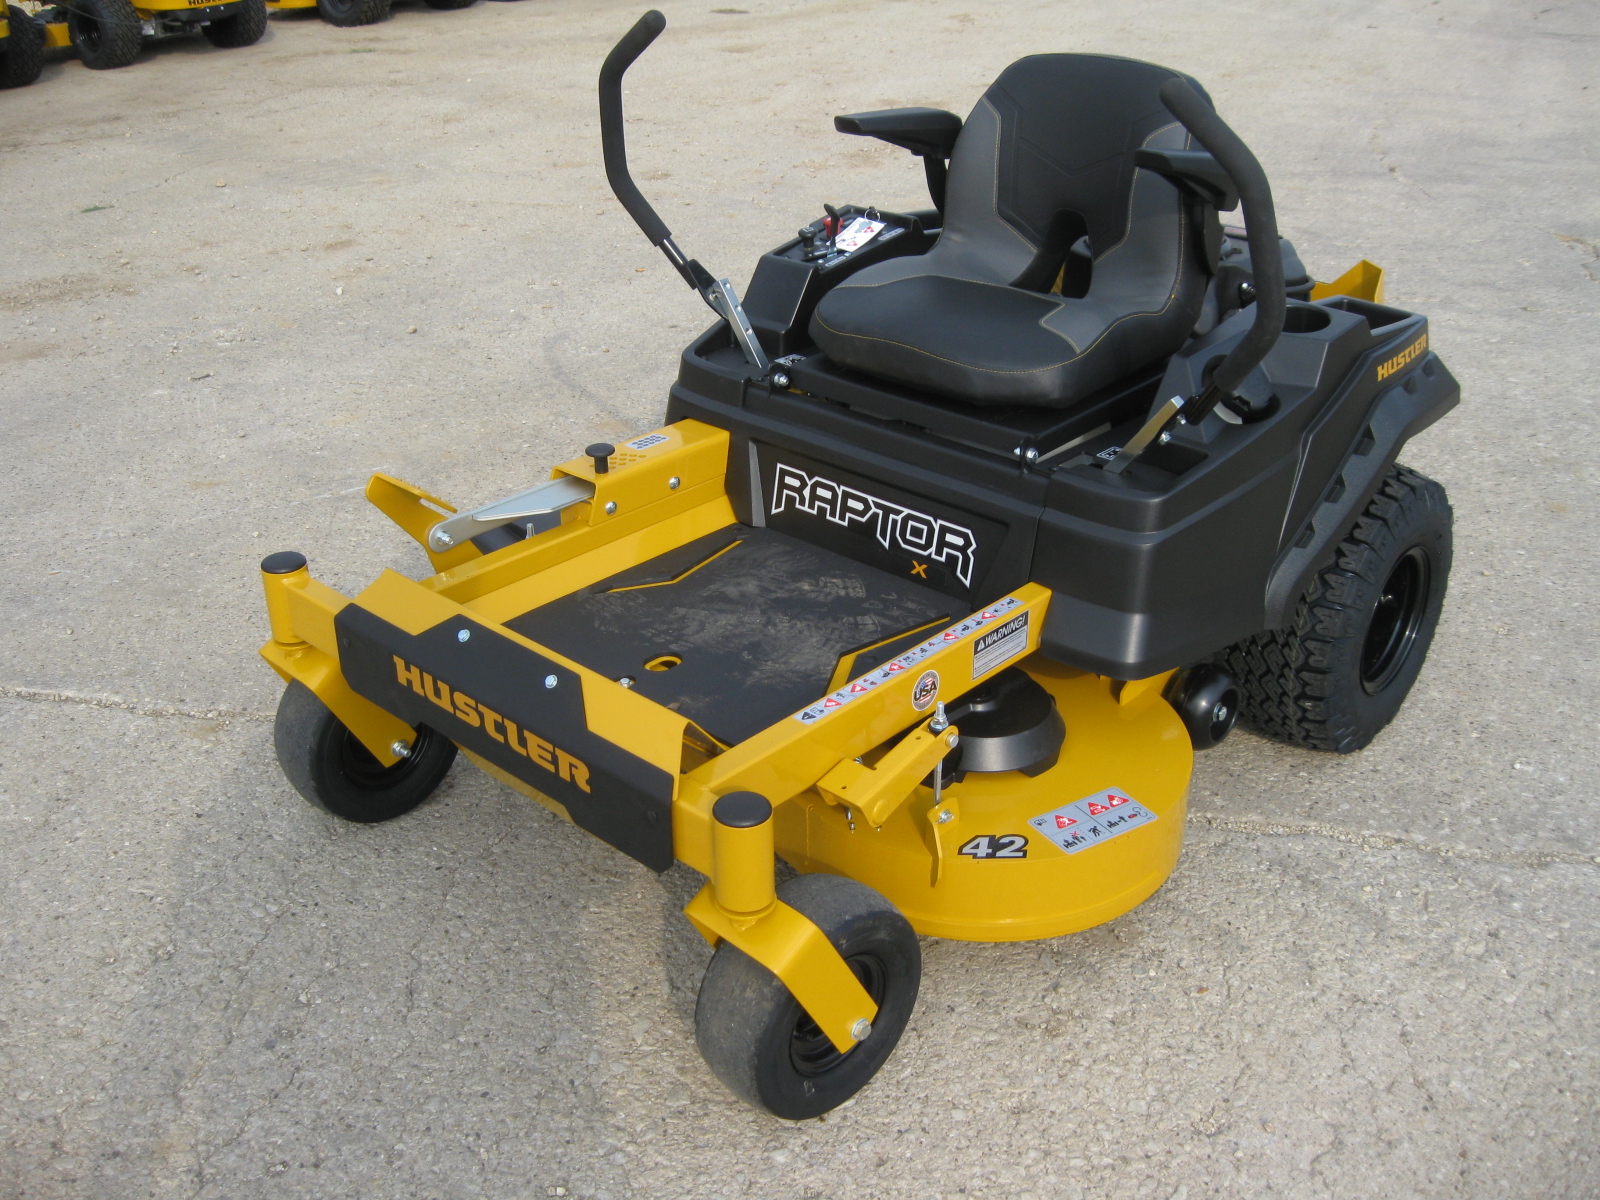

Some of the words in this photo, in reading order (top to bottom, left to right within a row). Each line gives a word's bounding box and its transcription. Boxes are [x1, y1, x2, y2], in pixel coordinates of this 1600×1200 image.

[1377, 333, 1427, 382] HUSTLER
[771, 463, 977, 589] RAPTOR
[985, 615, 1026, 647] WARNING!
[914, 680, 937, 702] USA
[392, 654, 591, 794] HUSTLER
[958, 834, 1029, 859] 42
